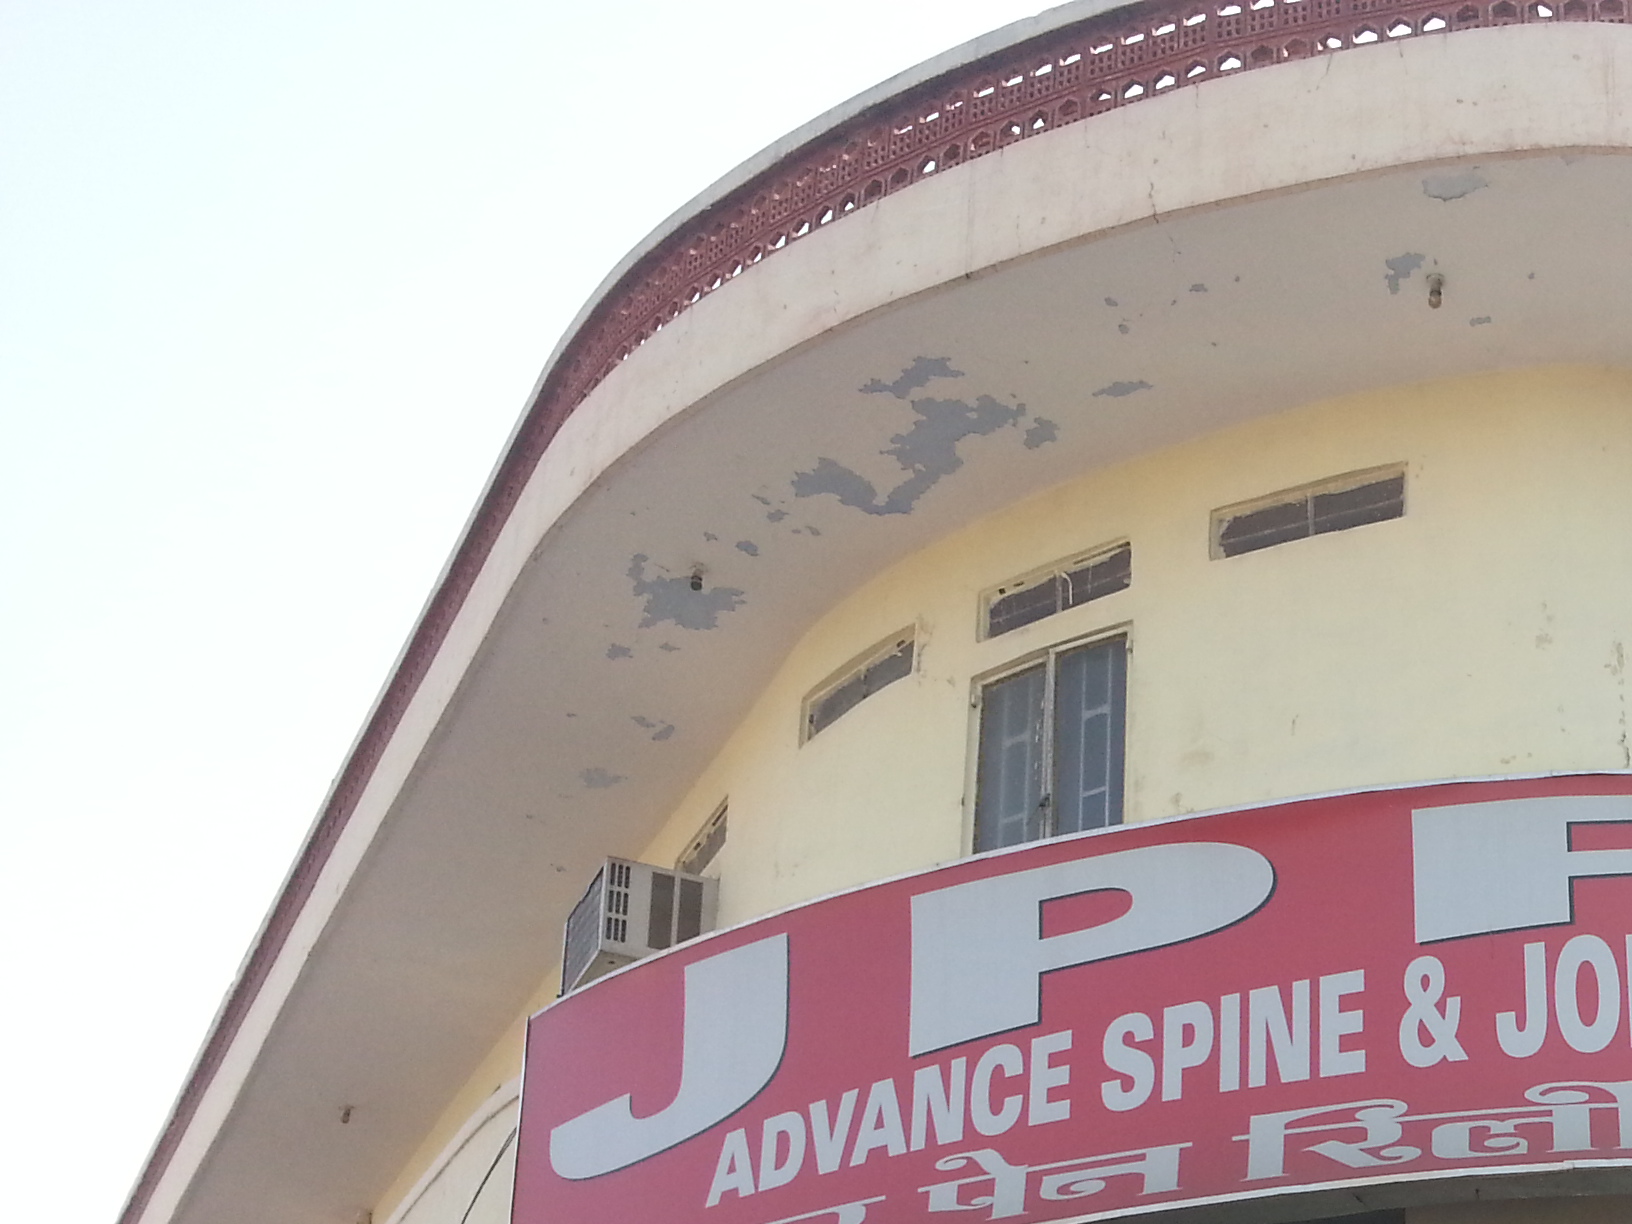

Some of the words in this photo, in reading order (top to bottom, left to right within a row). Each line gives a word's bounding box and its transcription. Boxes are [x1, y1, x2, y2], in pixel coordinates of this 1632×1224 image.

[705, 1028, 1072, 1208] ADVANCE
[1101, 969, 1365, 1113] SPINE
[1399, 955, 1469, 1068] &
[918, 1148, 1193, 1220] पेन
